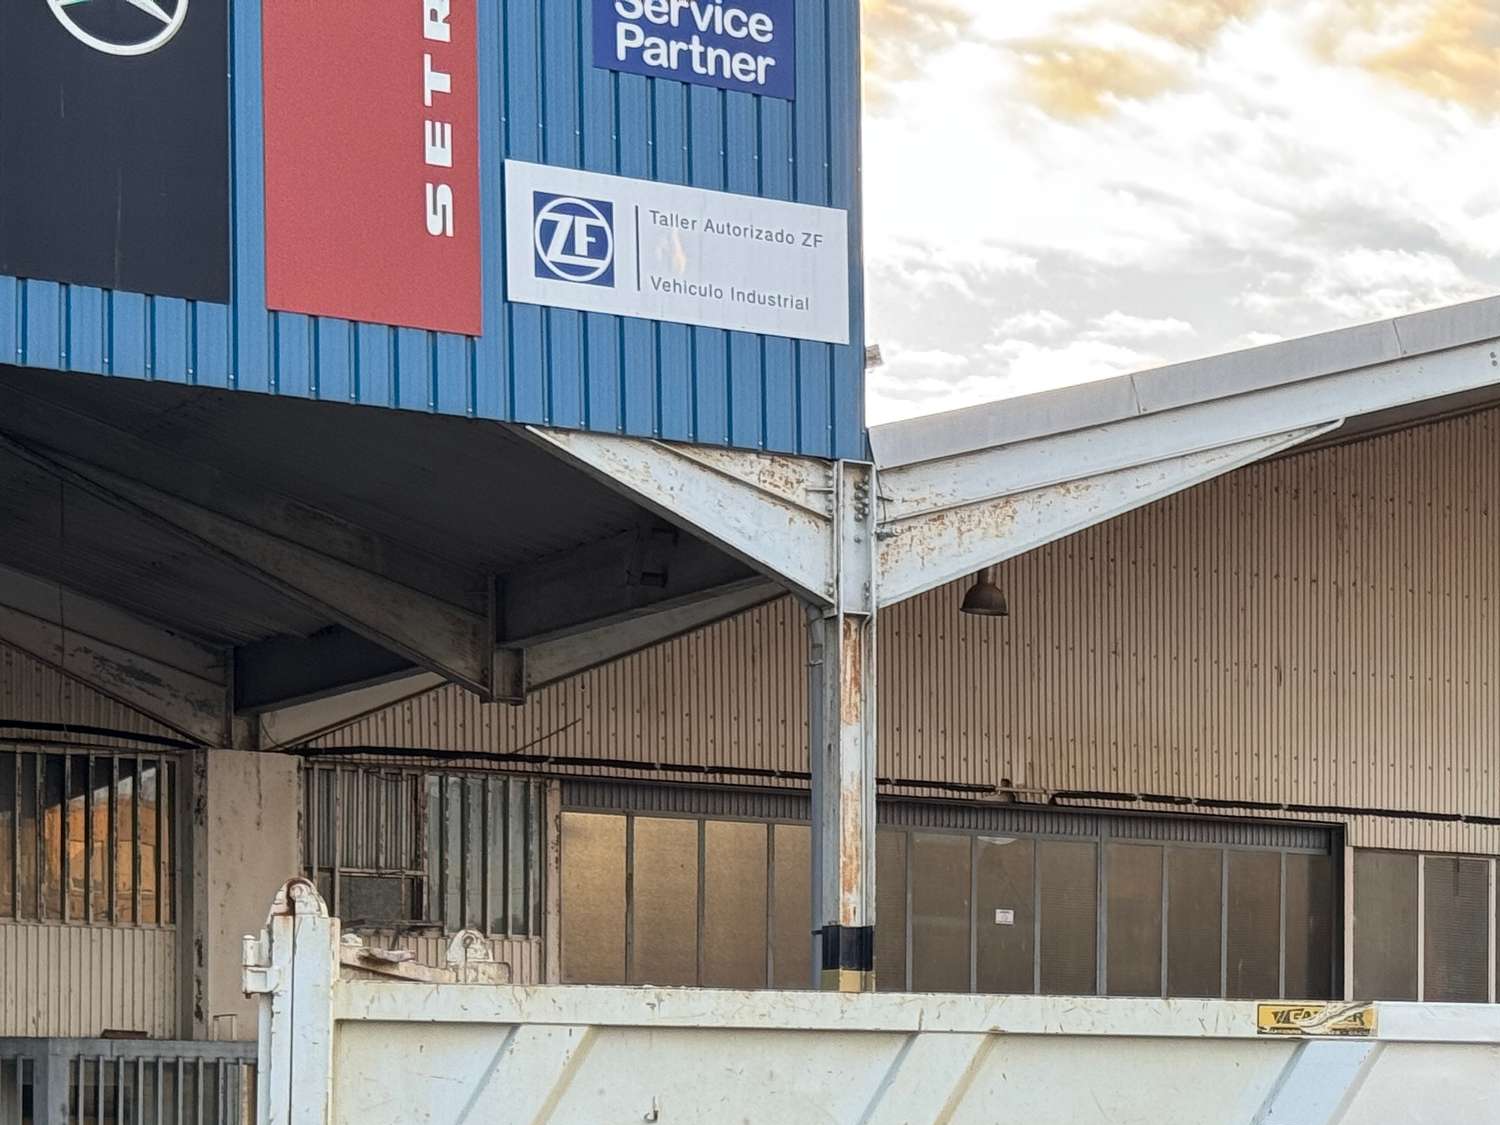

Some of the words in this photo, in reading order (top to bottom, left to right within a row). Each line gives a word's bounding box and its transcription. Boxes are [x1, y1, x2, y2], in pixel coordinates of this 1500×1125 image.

[616, 21, 776, 85] Partner
[537, 206, 609, 271] ZF
[650, 210, 697, 231] Taller
[703, 219, 795, 245] Autorizado
[801, 231, 824, 249] ZF
[730, 286, 810, 311] Industrial
